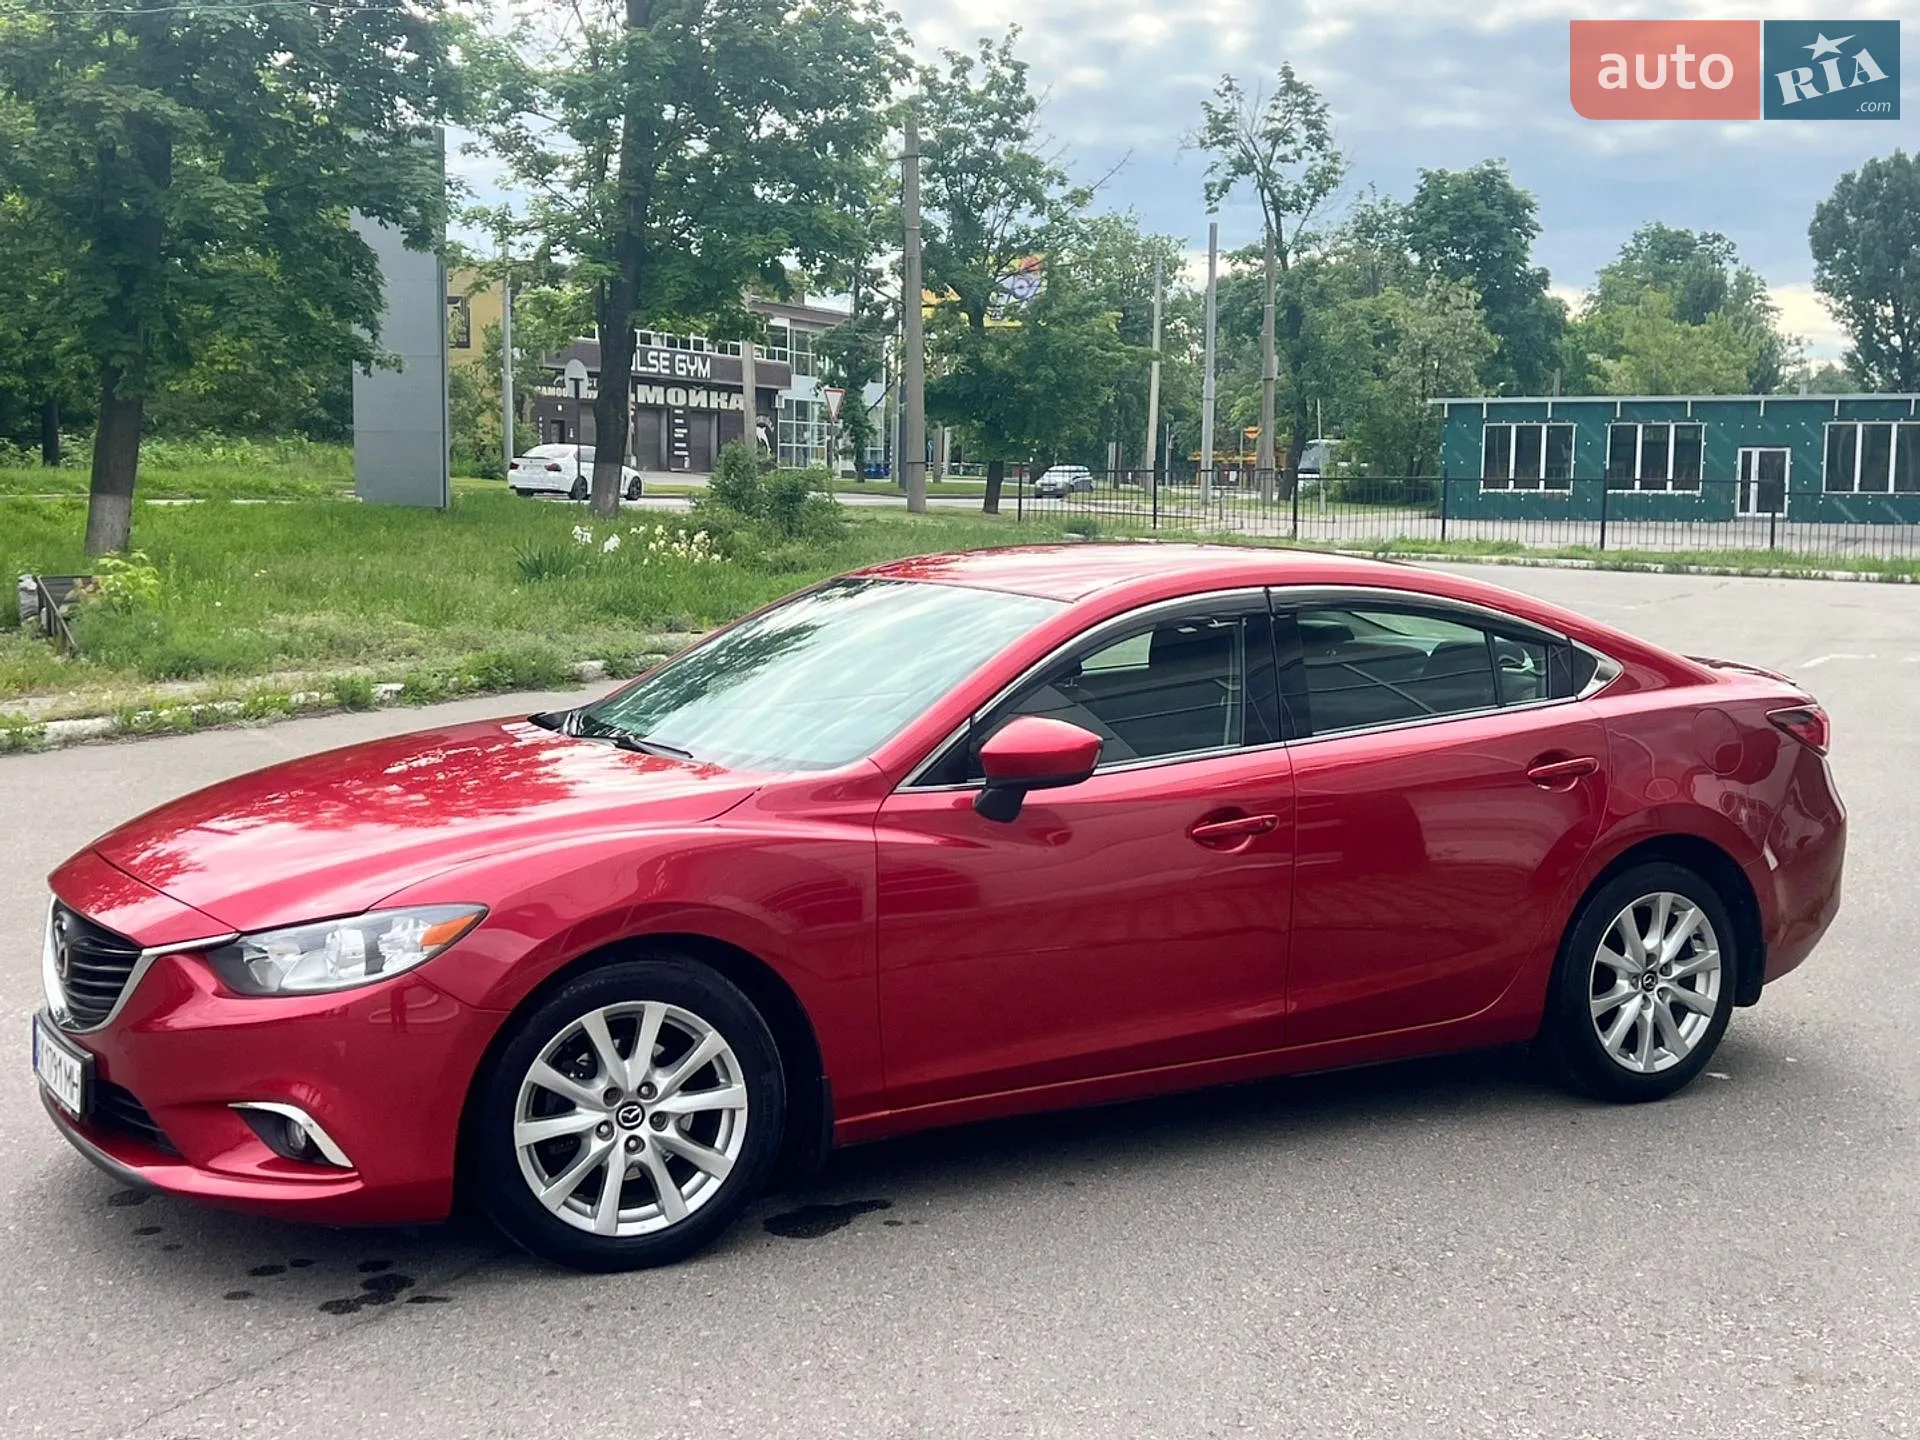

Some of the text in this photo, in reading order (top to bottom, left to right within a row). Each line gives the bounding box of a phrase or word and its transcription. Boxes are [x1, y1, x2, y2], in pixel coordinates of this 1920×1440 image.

[631, 349, 711, 379] LSE GYM
[637, 384, 744, 411] МОЙКА
